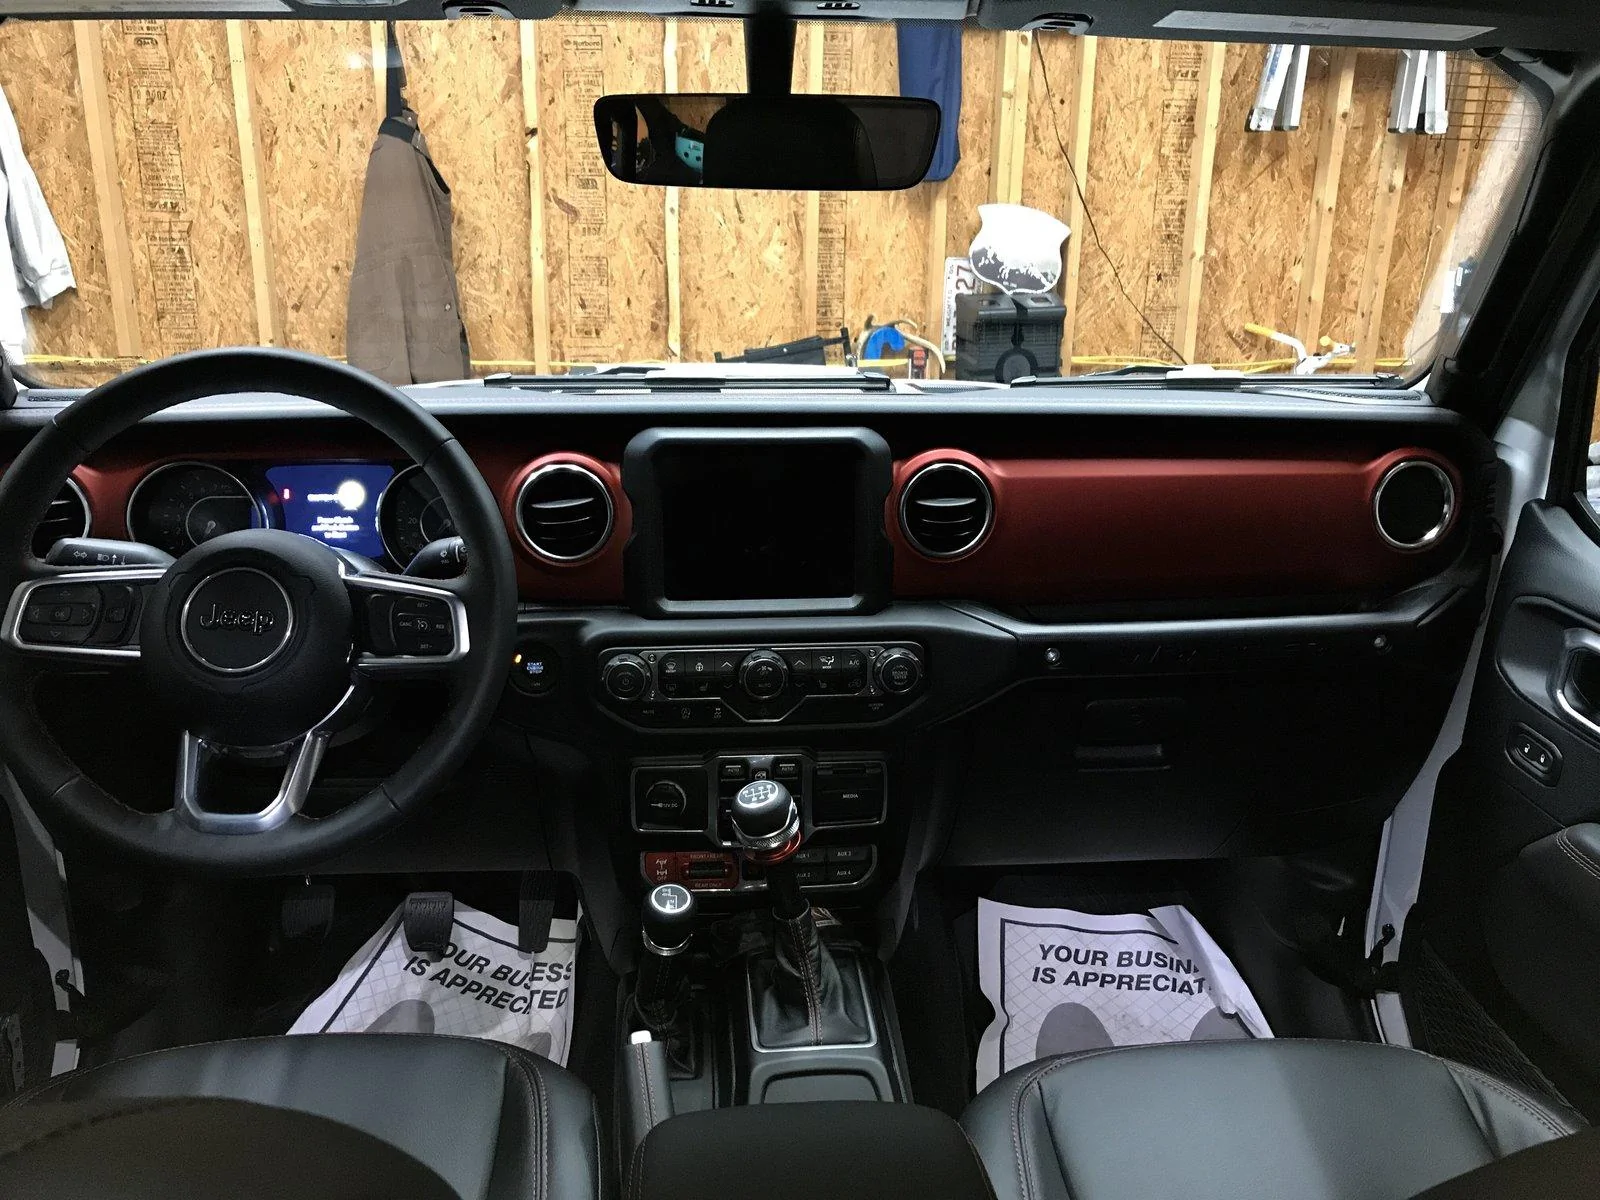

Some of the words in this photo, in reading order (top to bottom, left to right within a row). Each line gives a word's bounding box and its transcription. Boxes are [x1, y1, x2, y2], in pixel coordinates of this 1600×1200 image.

[200, 601, 276, 636] Jeep
[403, 956, 431, 976] IS
[444, 942, 490, 974] OUR
[1039, 944, 1109, 966] YOUR
[1032, 967, 1056, 984] IS
[1063, 971, 1204, 995] APPRECIAT
